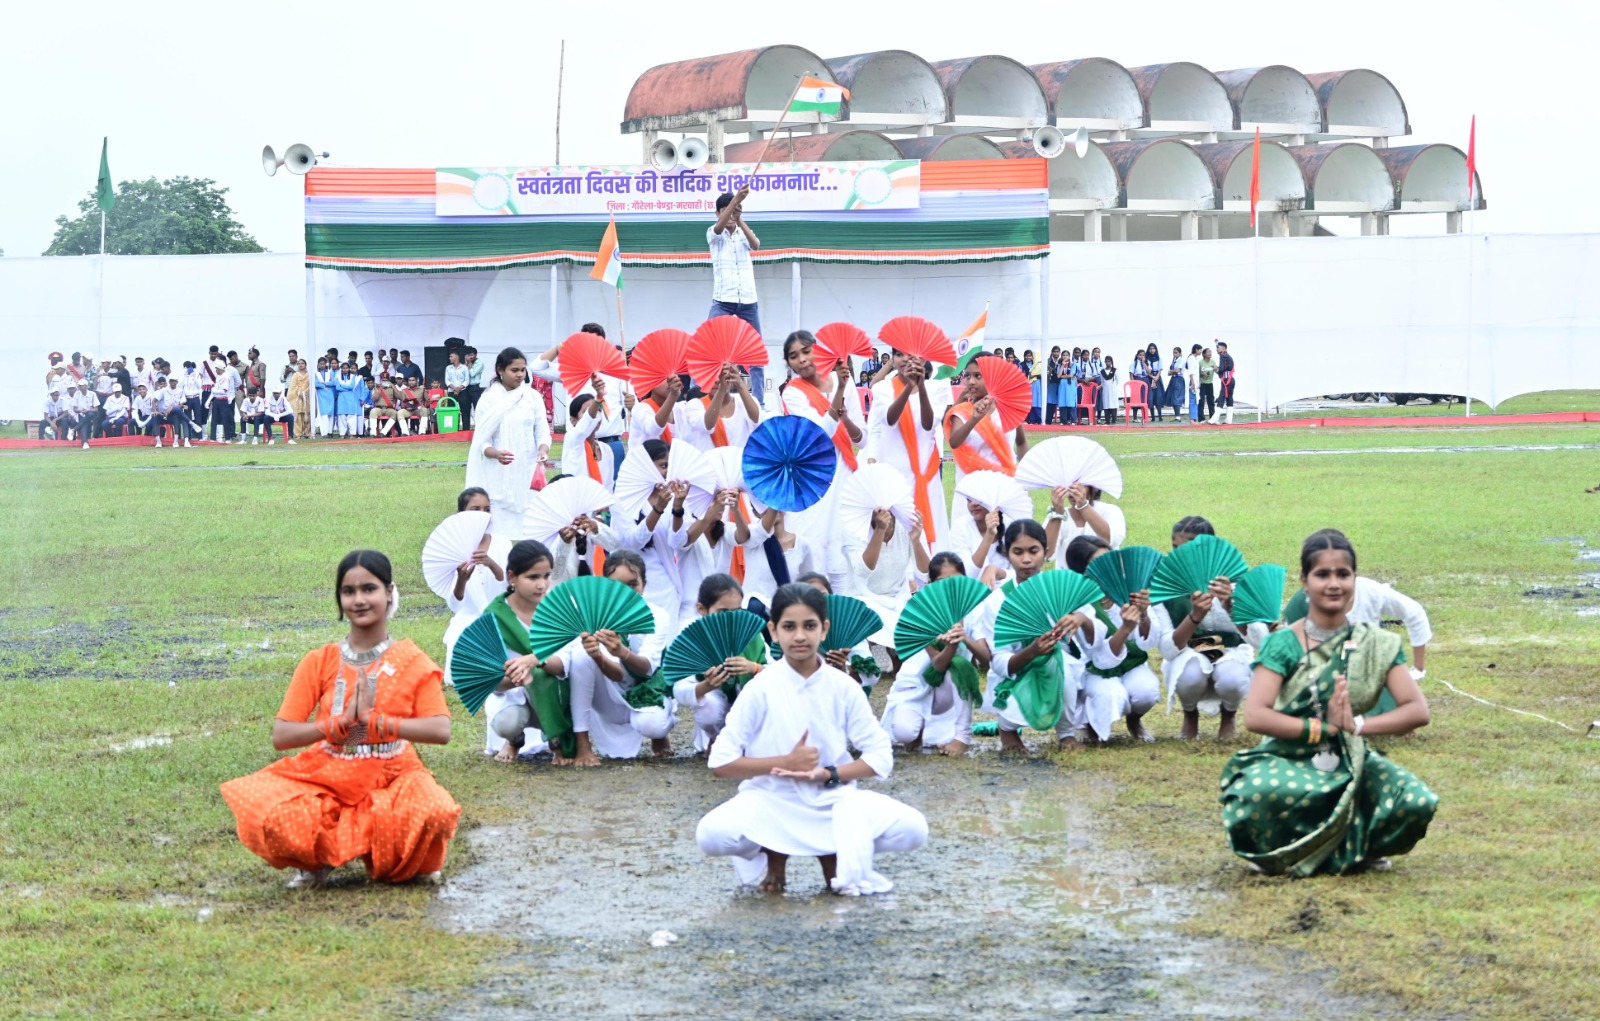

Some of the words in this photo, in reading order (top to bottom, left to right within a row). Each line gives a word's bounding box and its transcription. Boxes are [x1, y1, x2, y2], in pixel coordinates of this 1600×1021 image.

[517, 172, 582, 195] स्वतंत्रता
[586, 171, 632, 194] दिवस
[635, 170, 658, 193] की
[661, 169, 713, 192] हार्दिक
